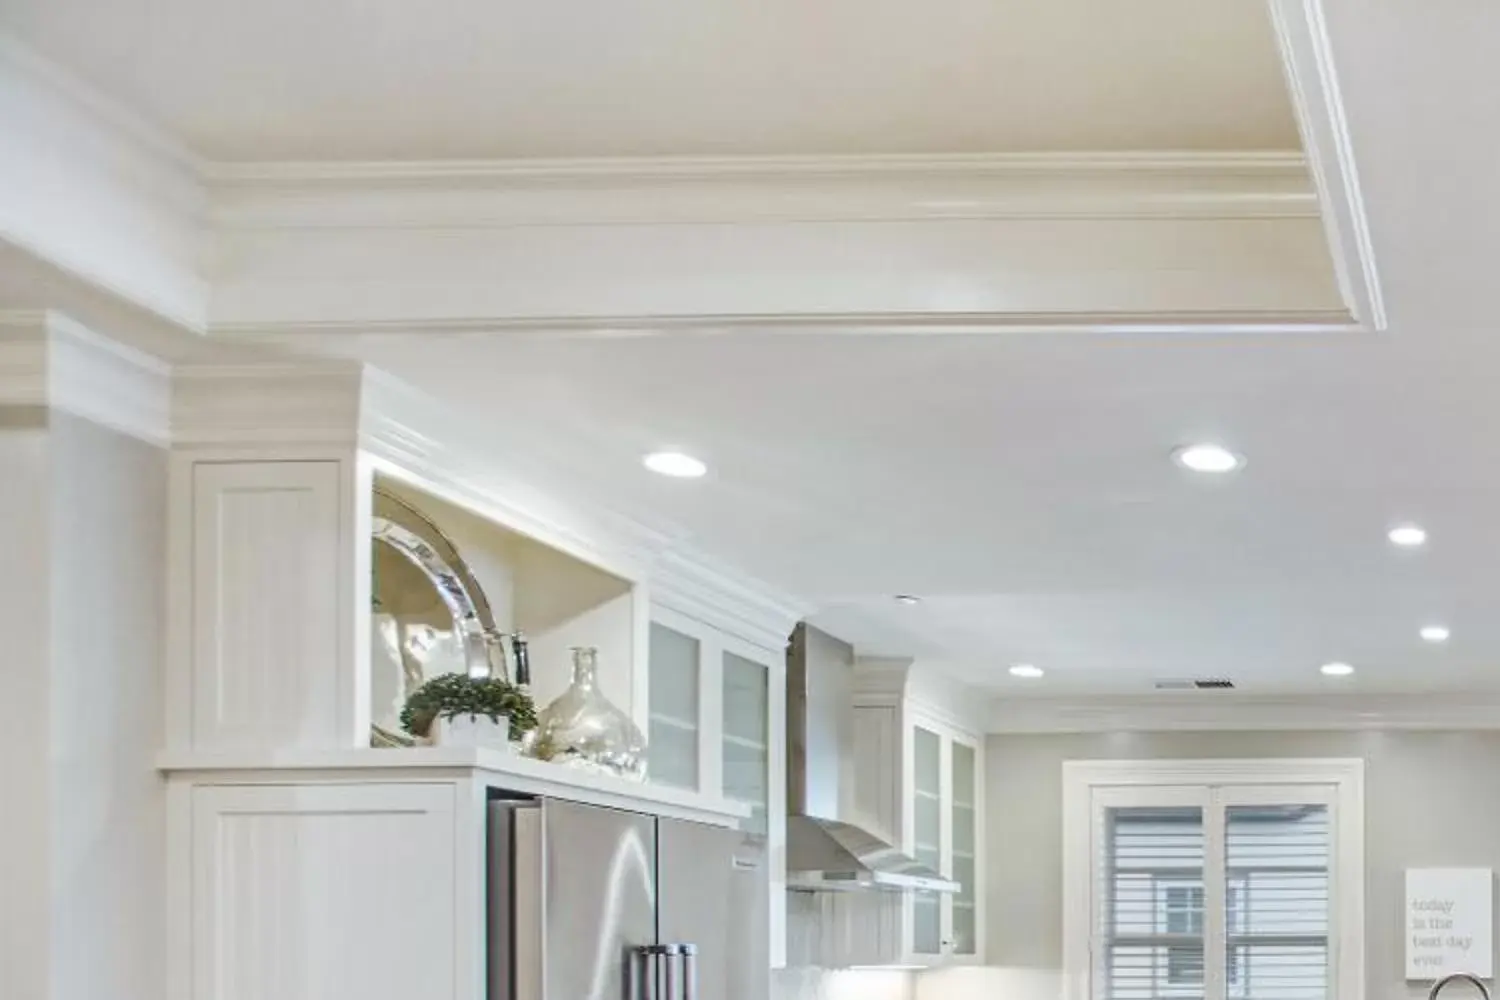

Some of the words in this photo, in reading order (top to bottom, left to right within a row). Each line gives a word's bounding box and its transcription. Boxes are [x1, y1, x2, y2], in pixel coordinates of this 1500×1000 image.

[1412, 898, 1454, 914] today
[1429, 918, 1453, 930] the
[1446, 935, 1473, 950] day
